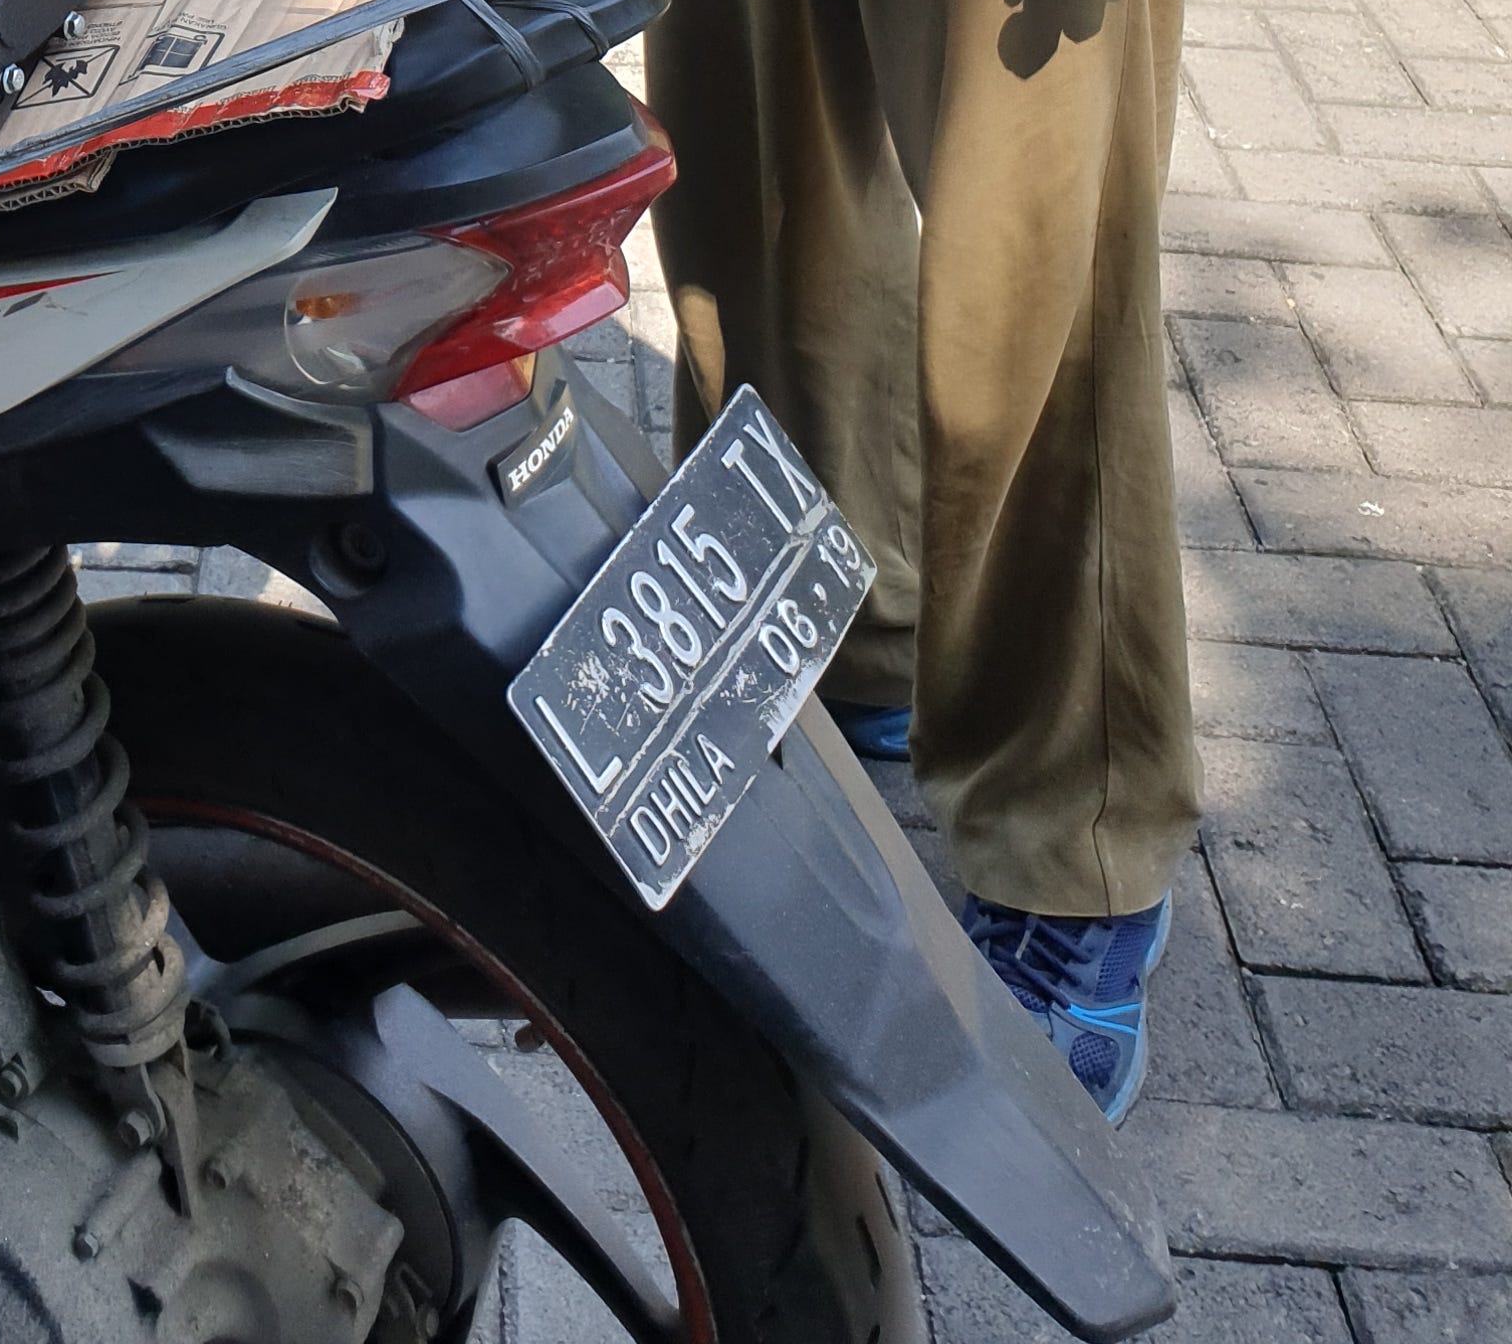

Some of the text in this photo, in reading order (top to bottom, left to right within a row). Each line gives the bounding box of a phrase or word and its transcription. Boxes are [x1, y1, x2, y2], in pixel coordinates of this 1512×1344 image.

[508, 406, 574, 491] HONDA
[534, 409, 816, 796] L 3815 TX
[628, 732, 737, 868] DHILA
